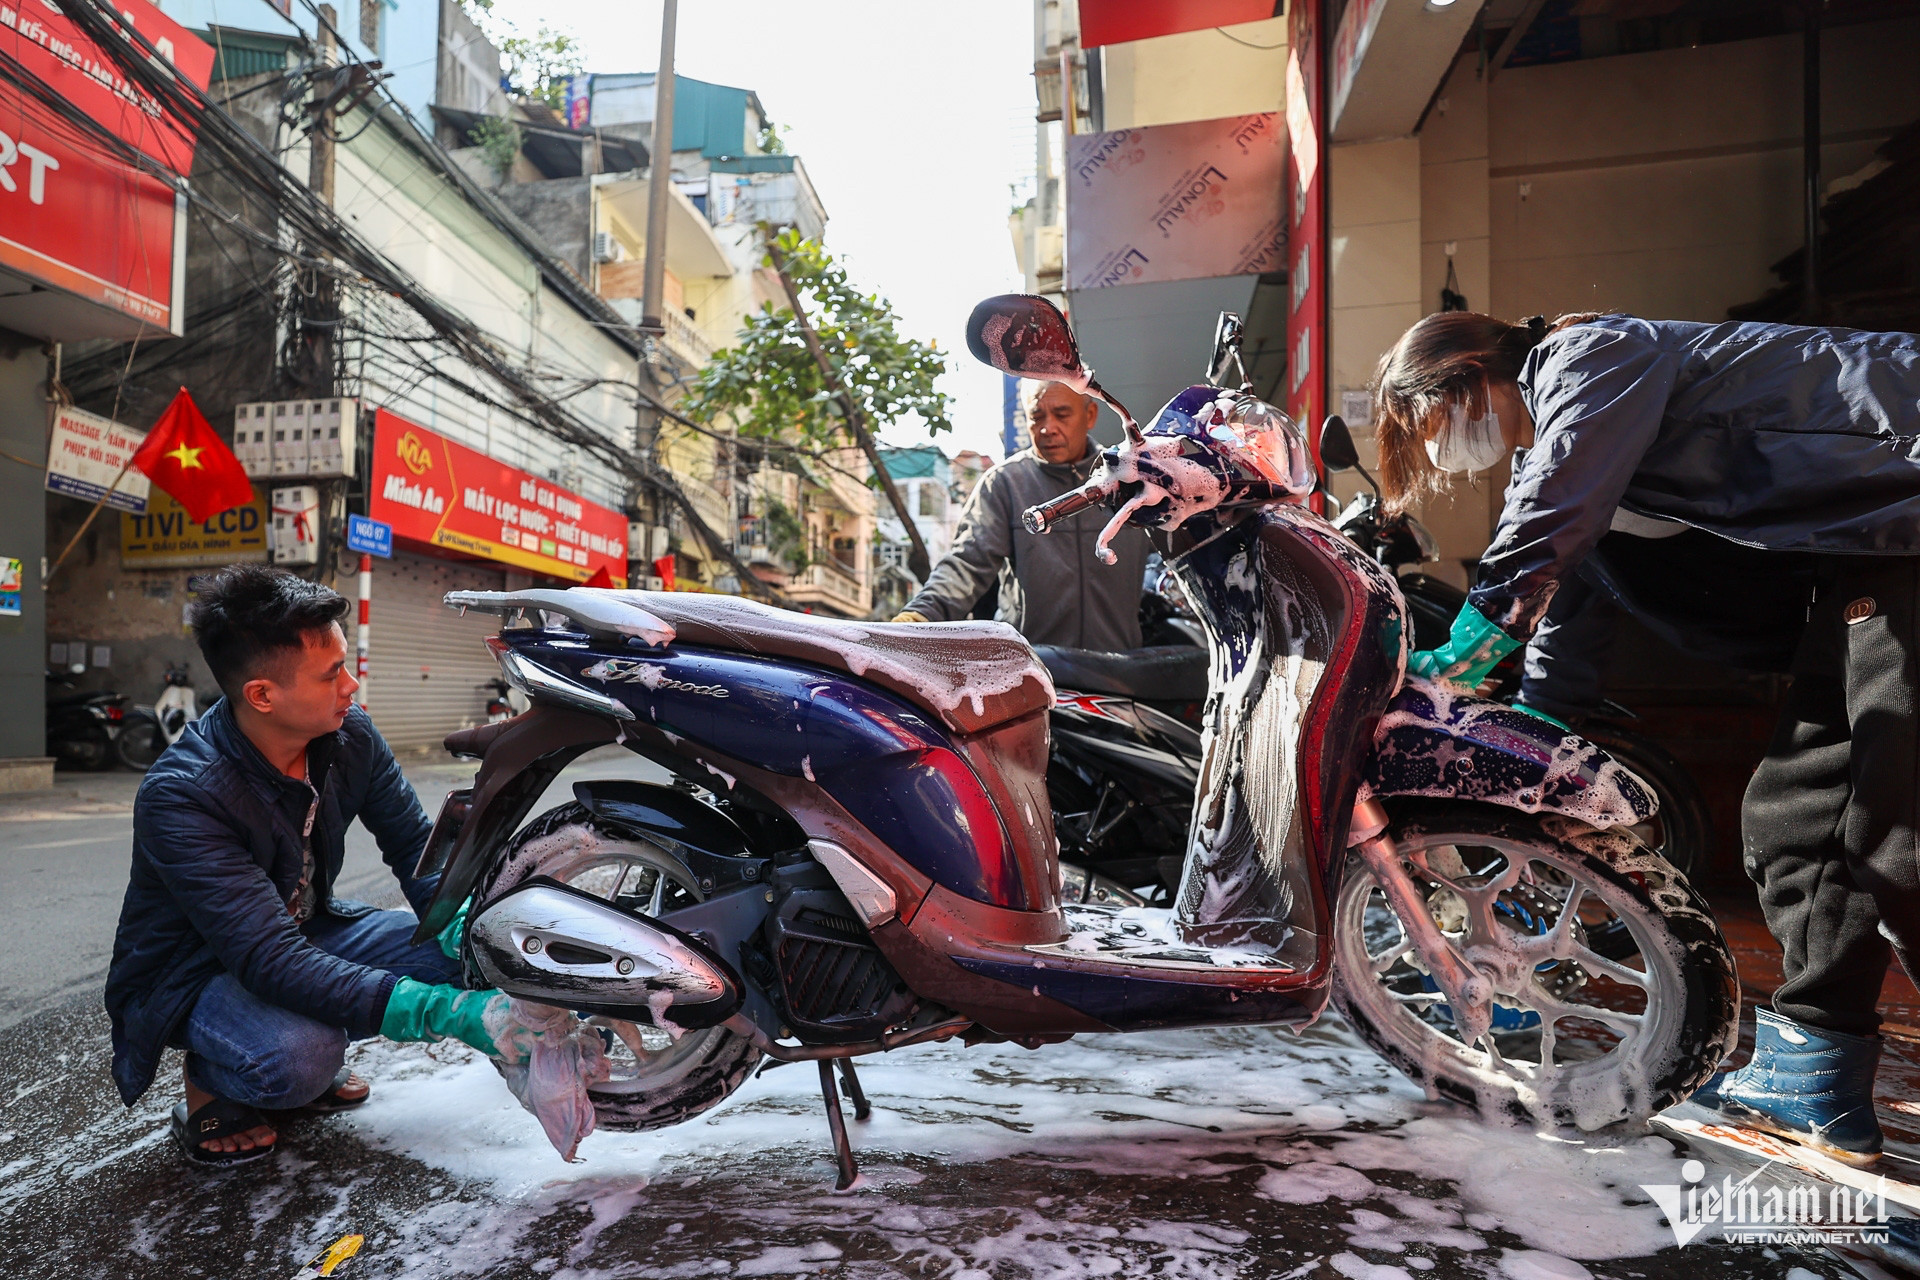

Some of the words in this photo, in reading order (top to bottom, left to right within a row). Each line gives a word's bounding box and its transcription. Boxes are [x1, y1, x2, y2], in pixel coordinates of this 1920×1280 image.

[18, 17, 48, 46] KẾT
[50, 39, 83, 71] VIỆC
[1100, 248, 1150, 289] LION
[60, 416, 101, 441] MASSAGE
[383, 474, 423, 509] Minh
[422, 487, 444, 515] An
[464, 487, 495, 516] MÁY
[495, 499, 518, 527] LỌC
[519, 508, 549, 535] NƯỚC
[537, 487, 555, 510] GIA
[556, 495, 582, 521] DỤNG
[130, 511, 183, 538] TIVI
[203, 507, 259, 535] LCD
